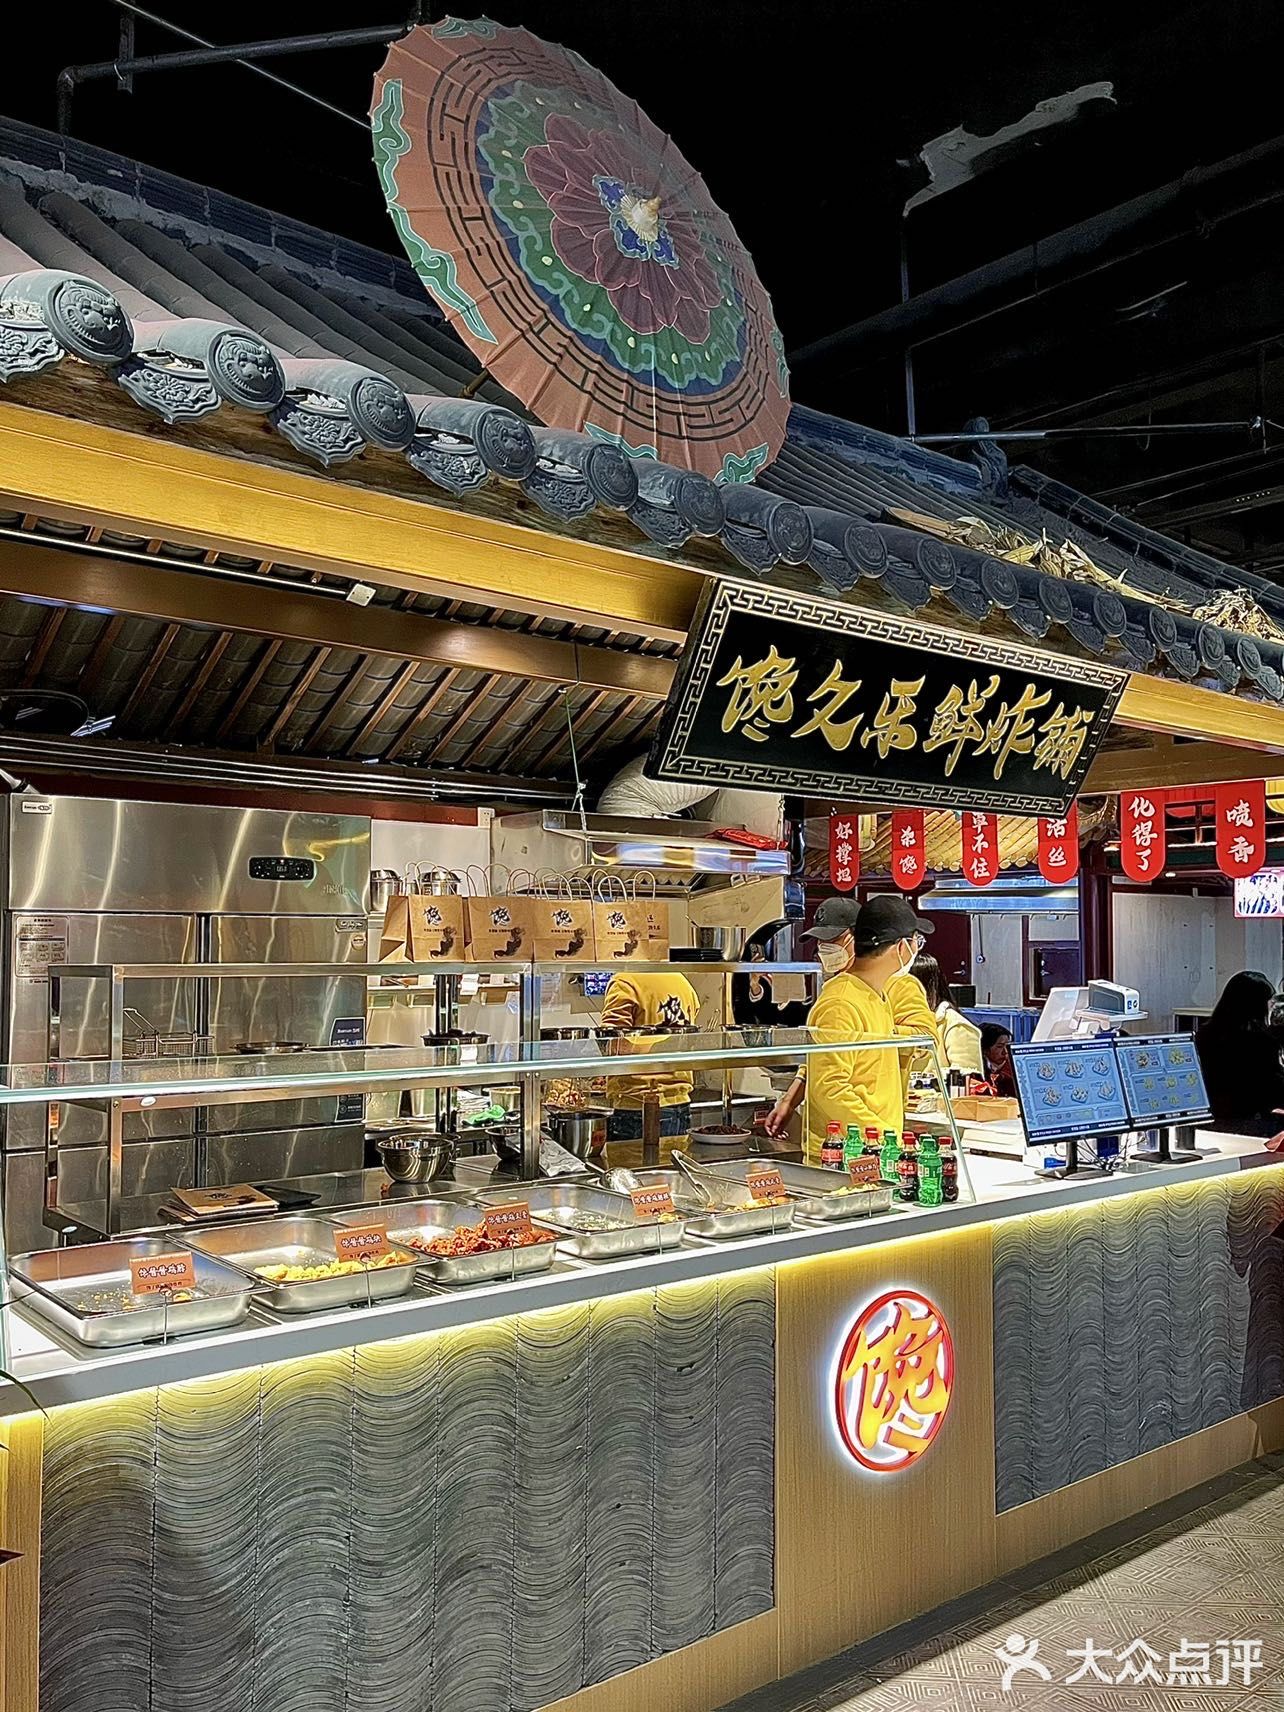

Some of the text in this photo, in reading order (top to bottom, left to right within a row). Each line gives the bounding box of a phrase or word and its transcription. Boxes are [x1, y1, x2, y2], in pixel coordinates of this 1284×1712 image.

[716, 644, 1094, 781] 馋久乐鲜炸铺
[1128, 796, 1158, 872] 化得了
[1226, 799, 1254, 864] 喷香
[843, 1301, 950, 1453] 馋
